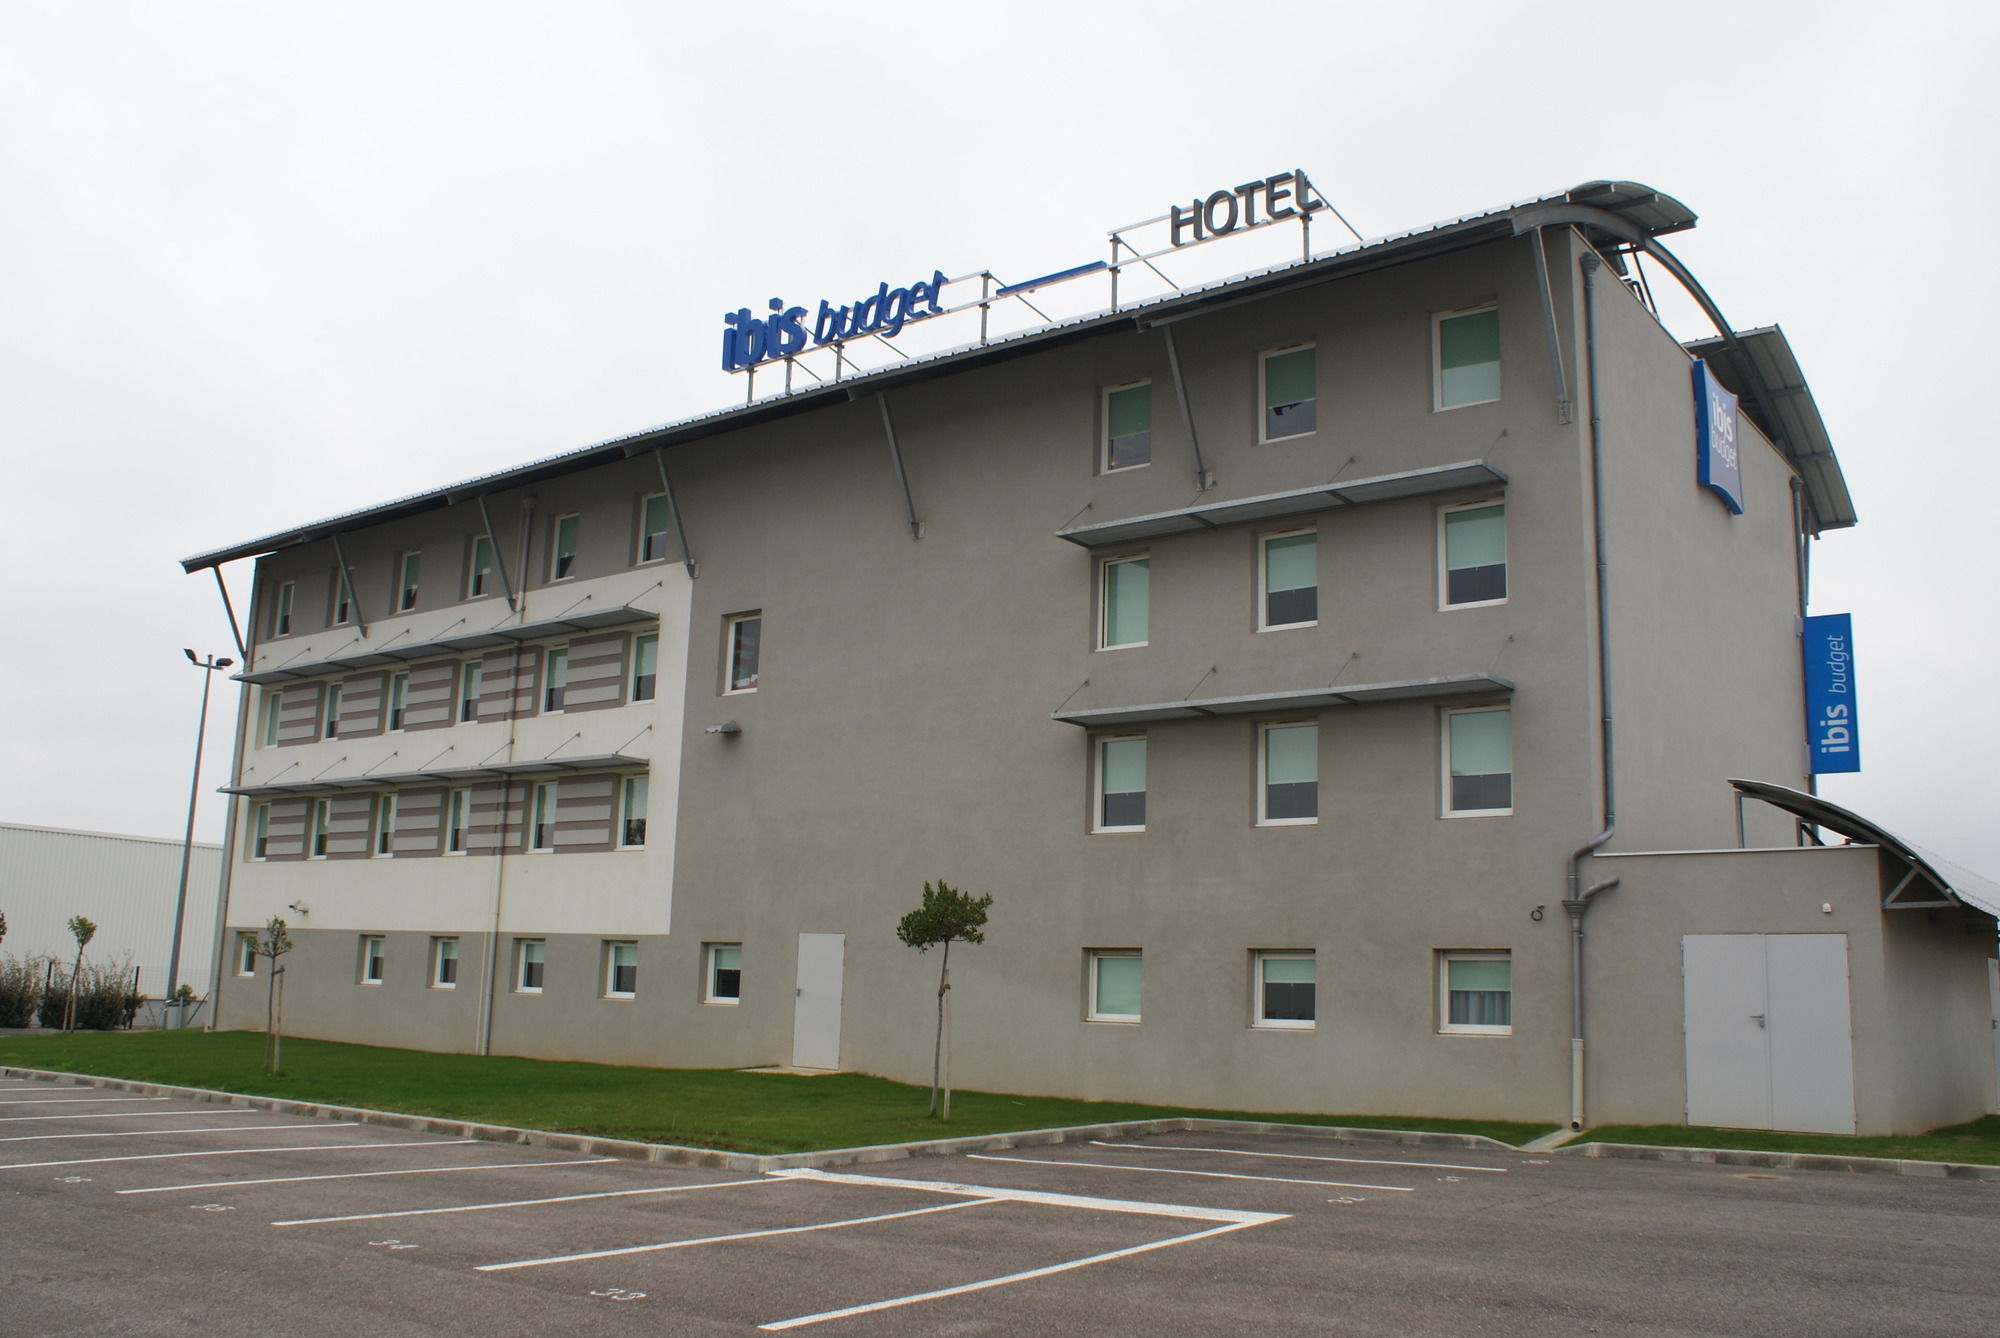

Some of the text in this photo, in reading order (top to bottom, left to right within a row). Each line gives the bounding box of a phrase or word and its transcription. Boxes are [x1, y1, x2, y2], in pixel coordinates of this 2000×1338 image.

[1171, 168, 1322, 247] HOTEL
[722, 269, 948, 372] ibis budget
[1712, 391, 1734, 443] ibis
[1820, 634, 1850, 753] ibis budget
[590, 1288, 648, 1301] 33
